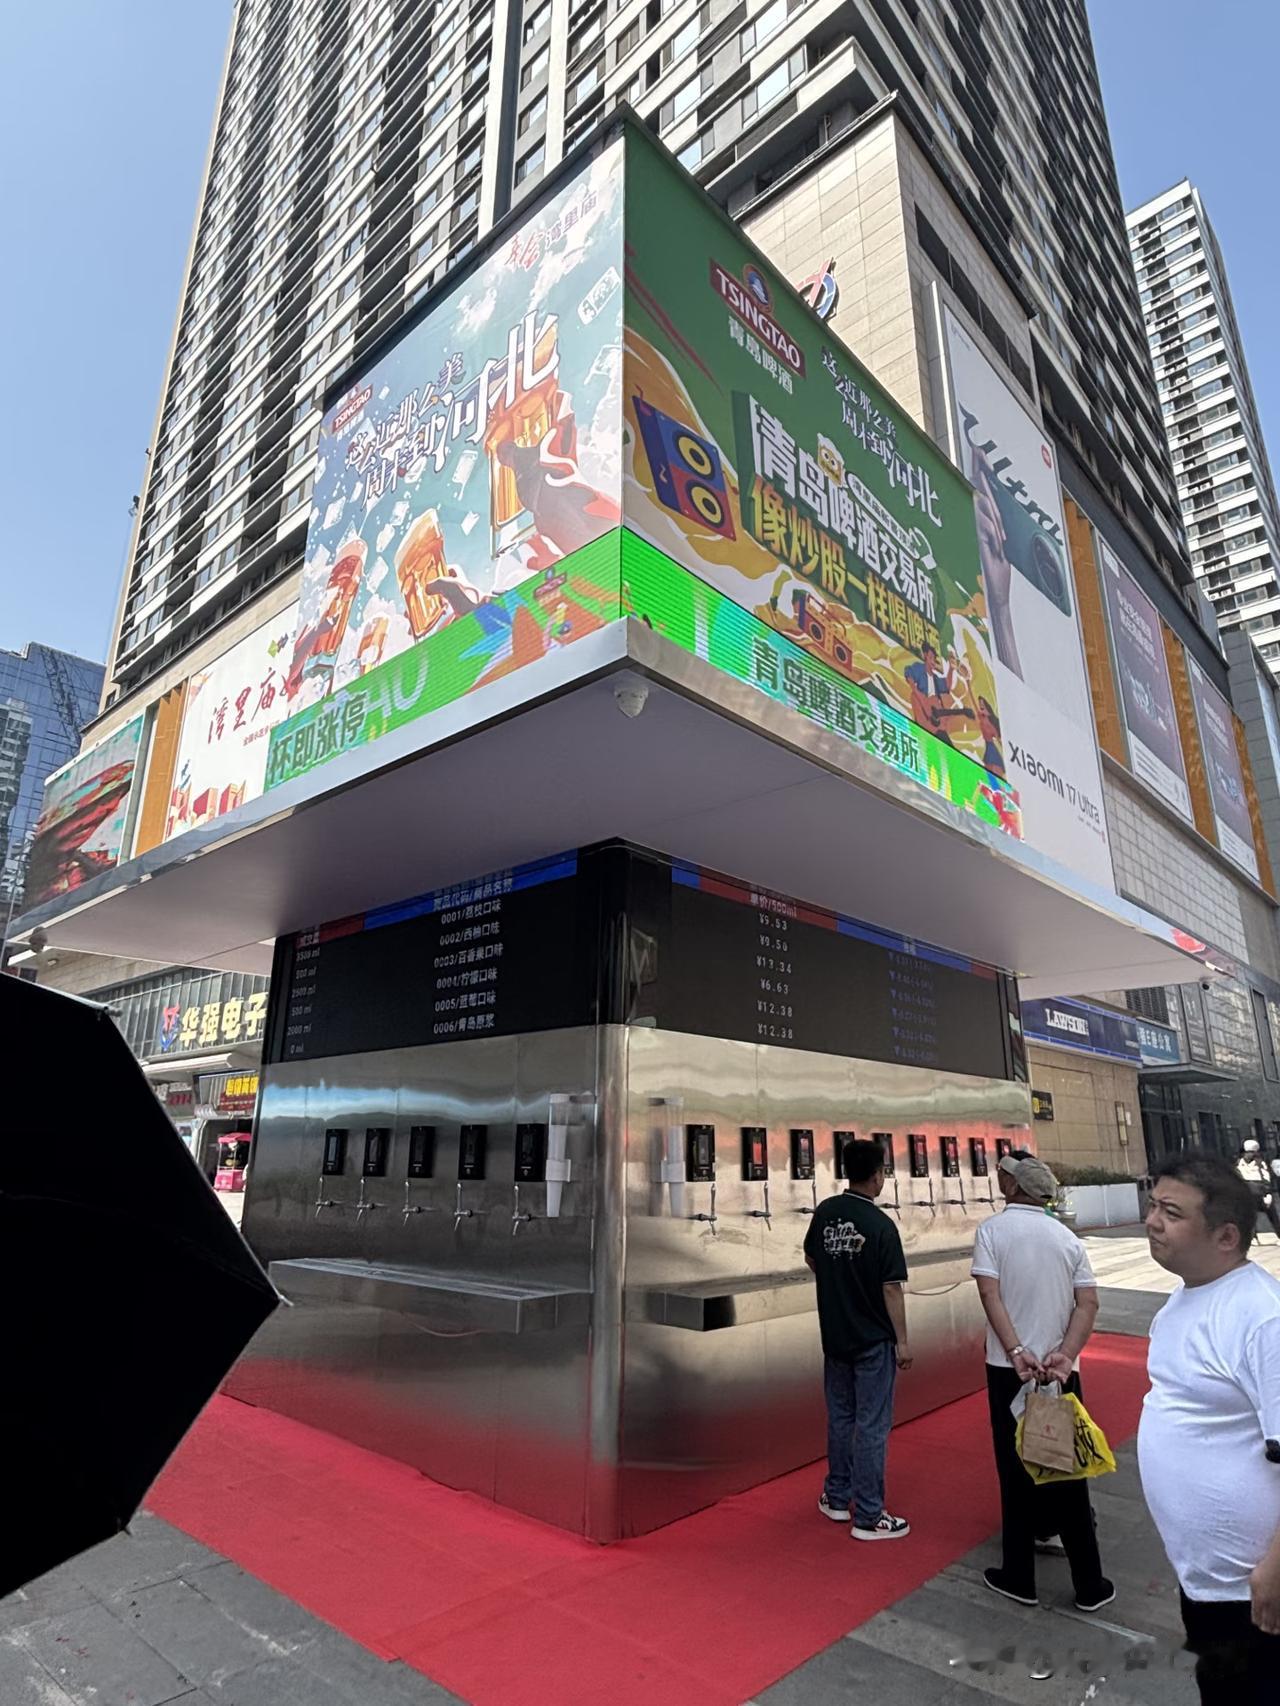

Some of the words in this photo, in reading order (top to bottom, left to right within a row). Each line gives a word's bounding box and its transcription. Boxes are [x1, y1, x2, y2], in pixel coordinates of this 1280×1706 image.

[716, 268, 801, 369] TSINGTAO
[728, 315, 793, 395] 青岛啤酒
[345, 352, 465, 476] 这么近那么美
[361, 309, 560, 512] 周末到河北
[841, 400, 943, 528] 周末到河北
[757, 400, 937, 624] 青岛啤酒交易所
[958, 401, 1064, 546] Ultra
[208, 667, 289, 744] 湾里庙
[752, 636, 919, 774] 青岛啤酒交易所
[179, 991, 268, 1048] 华强电子
[760, 977, 789, 995] ¥6.63
[1045, 1007, 1089, 1037] LAWSON
